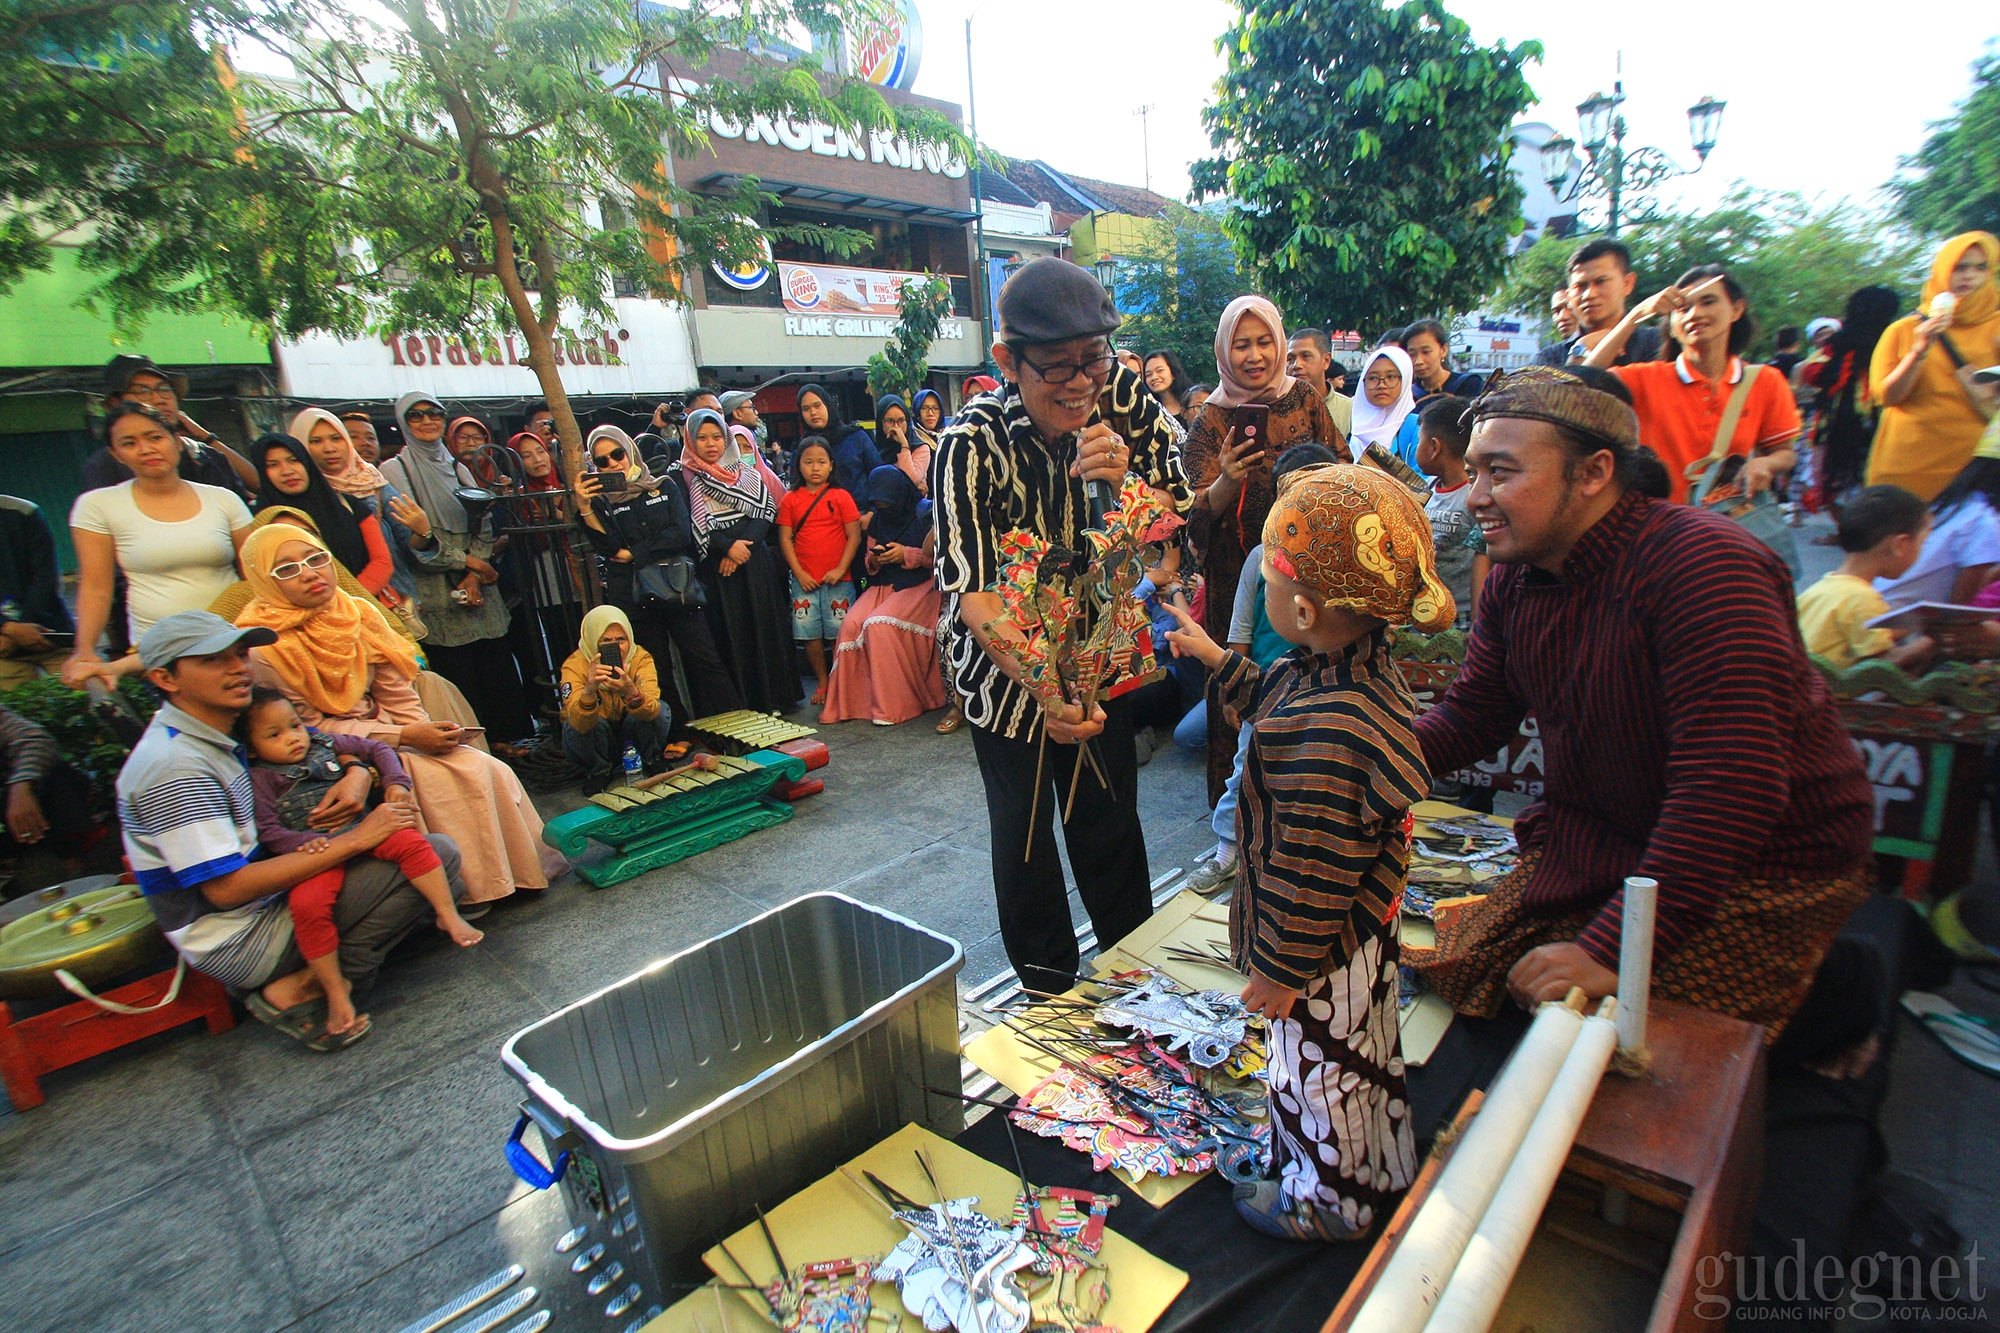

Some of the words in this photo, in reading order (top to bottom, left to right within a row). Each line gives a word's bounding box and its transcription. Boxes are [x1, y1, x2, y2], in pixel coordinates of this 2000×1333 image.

[790, 275, 815, 289] BURGER
[793, 282, 817, 298] KING
[784, 317, 833, 337] FLAME
[833, 319, 898, 338] GRILLING
[1424, 508, 1462, 525] OLICE
